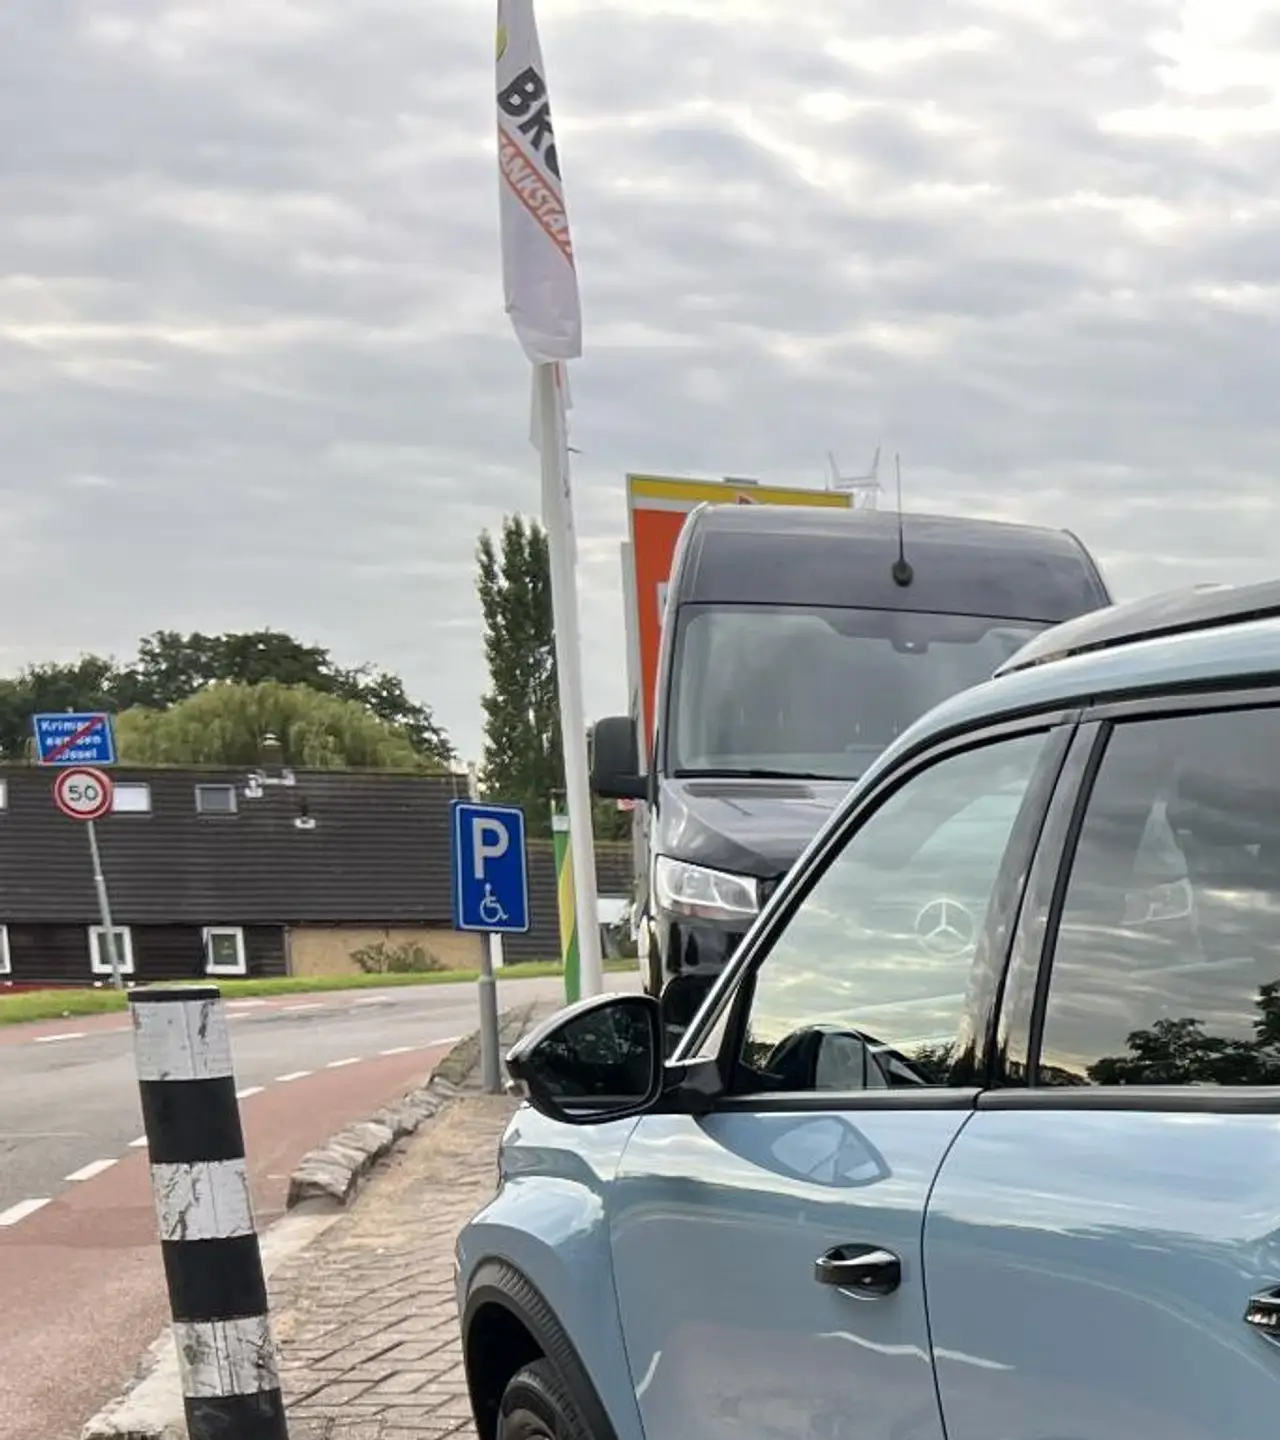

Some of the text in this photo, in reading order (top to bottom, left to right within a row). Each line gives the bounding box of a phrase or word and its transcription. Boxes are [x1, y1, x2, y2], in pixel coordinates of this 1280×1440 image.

[40, 720, 102, 731] Krimpn
[68, 784, 99, 802] 50
[472, 817, 509, 879] P
